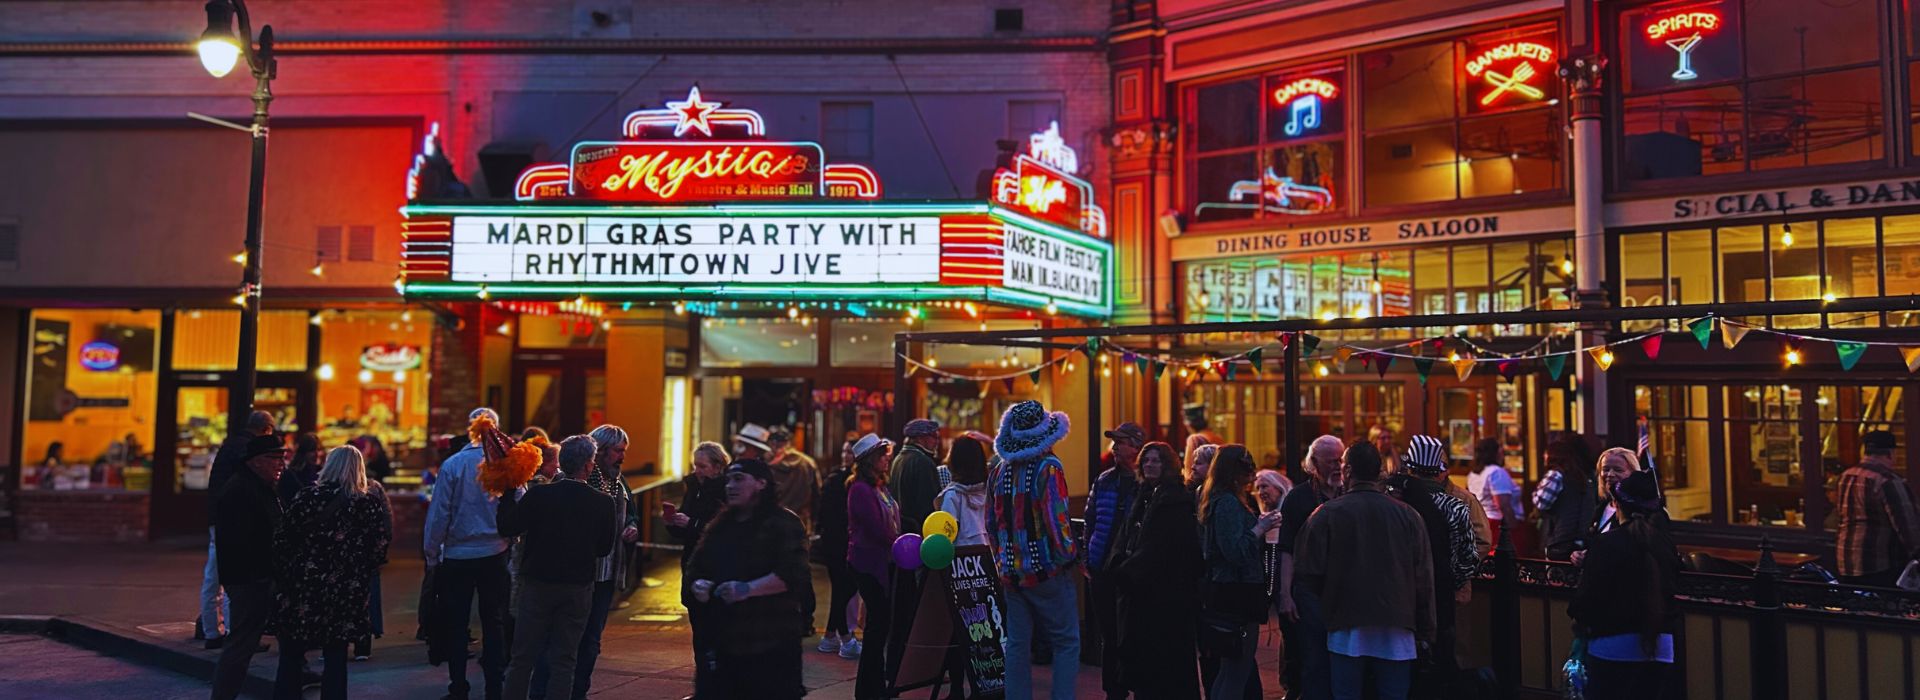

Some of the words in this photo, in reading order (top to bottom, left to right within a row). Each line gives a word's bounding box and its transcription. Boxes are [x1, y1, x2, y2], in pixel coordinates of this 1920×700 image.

[1647, 12, 1717, 39] SPIRITS
[1465, 42, 1553, 76] BANQUETS
[1274, 78, 1336, 105] DANCING
[600, 146, 793, 199] Mystic
[539, 185, 567, 197] Est.
[734, 184, 748, 195] &
[749, 184, 787, 196] Music
[788, 183, 814, 196] Hall
[828, 185, 857, 197] 1912
[1809, 188, 1834, 208] &
[487, 223, 586, 246] MARDI
[606, 223, 693, 246] GRAS
[719, 223, 825, 246] PARTY
[840, 223, 916, 246] WITH
[1216, 233, 1288, 254] DINING
[1300, 227, 1372, 247] HOUSE
[1399, 216, 1499, 240] SALOON
[1039, 239, 1061, 262] FILM
[526, 252, 749, 276] RHYTHMTOWN
[770, 253, 842, 275] JIVE
[1011, 260, 1034, 285] MAN
[952, 556, 985, 578] JACK
[954, 580, 971, 590] LIVES
[971, 578, 990, 588] HERE
